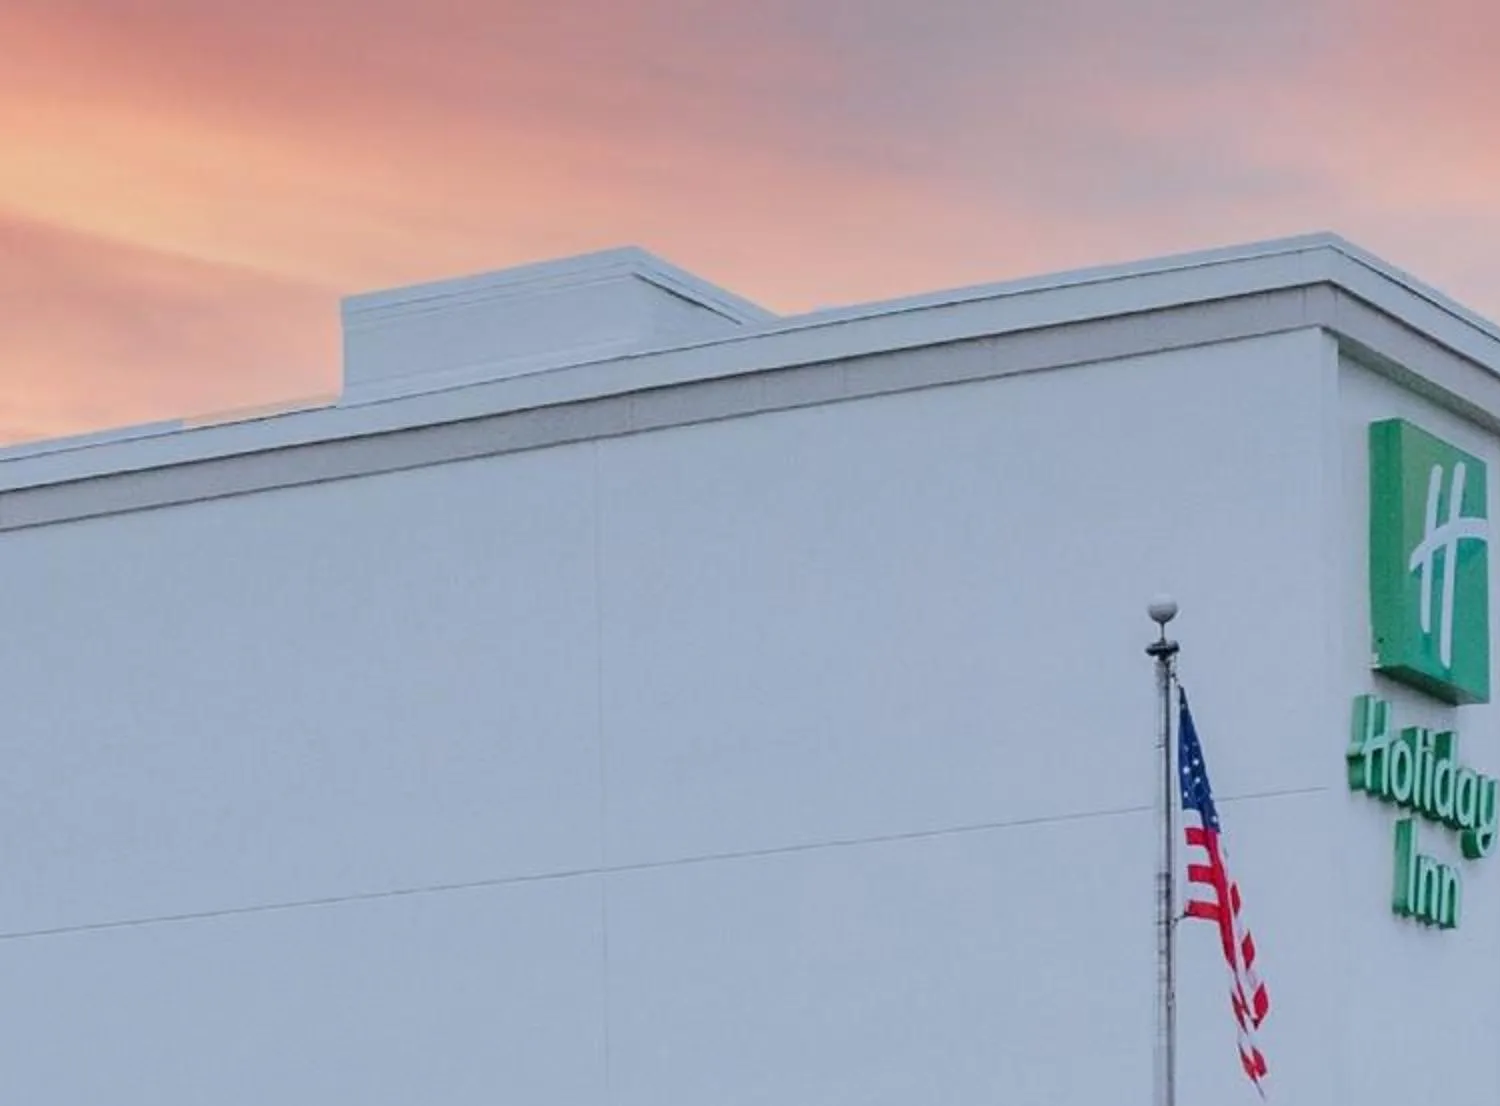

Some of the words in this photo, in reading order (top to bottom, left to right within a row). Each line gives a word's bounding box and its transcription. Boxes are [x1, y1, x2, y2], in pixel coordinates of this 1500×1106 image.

[1409, 461, 1488, 669] H
[1348, 694, 1500, 858] Holiday
[1393, 812, 1461, 929] Inn
